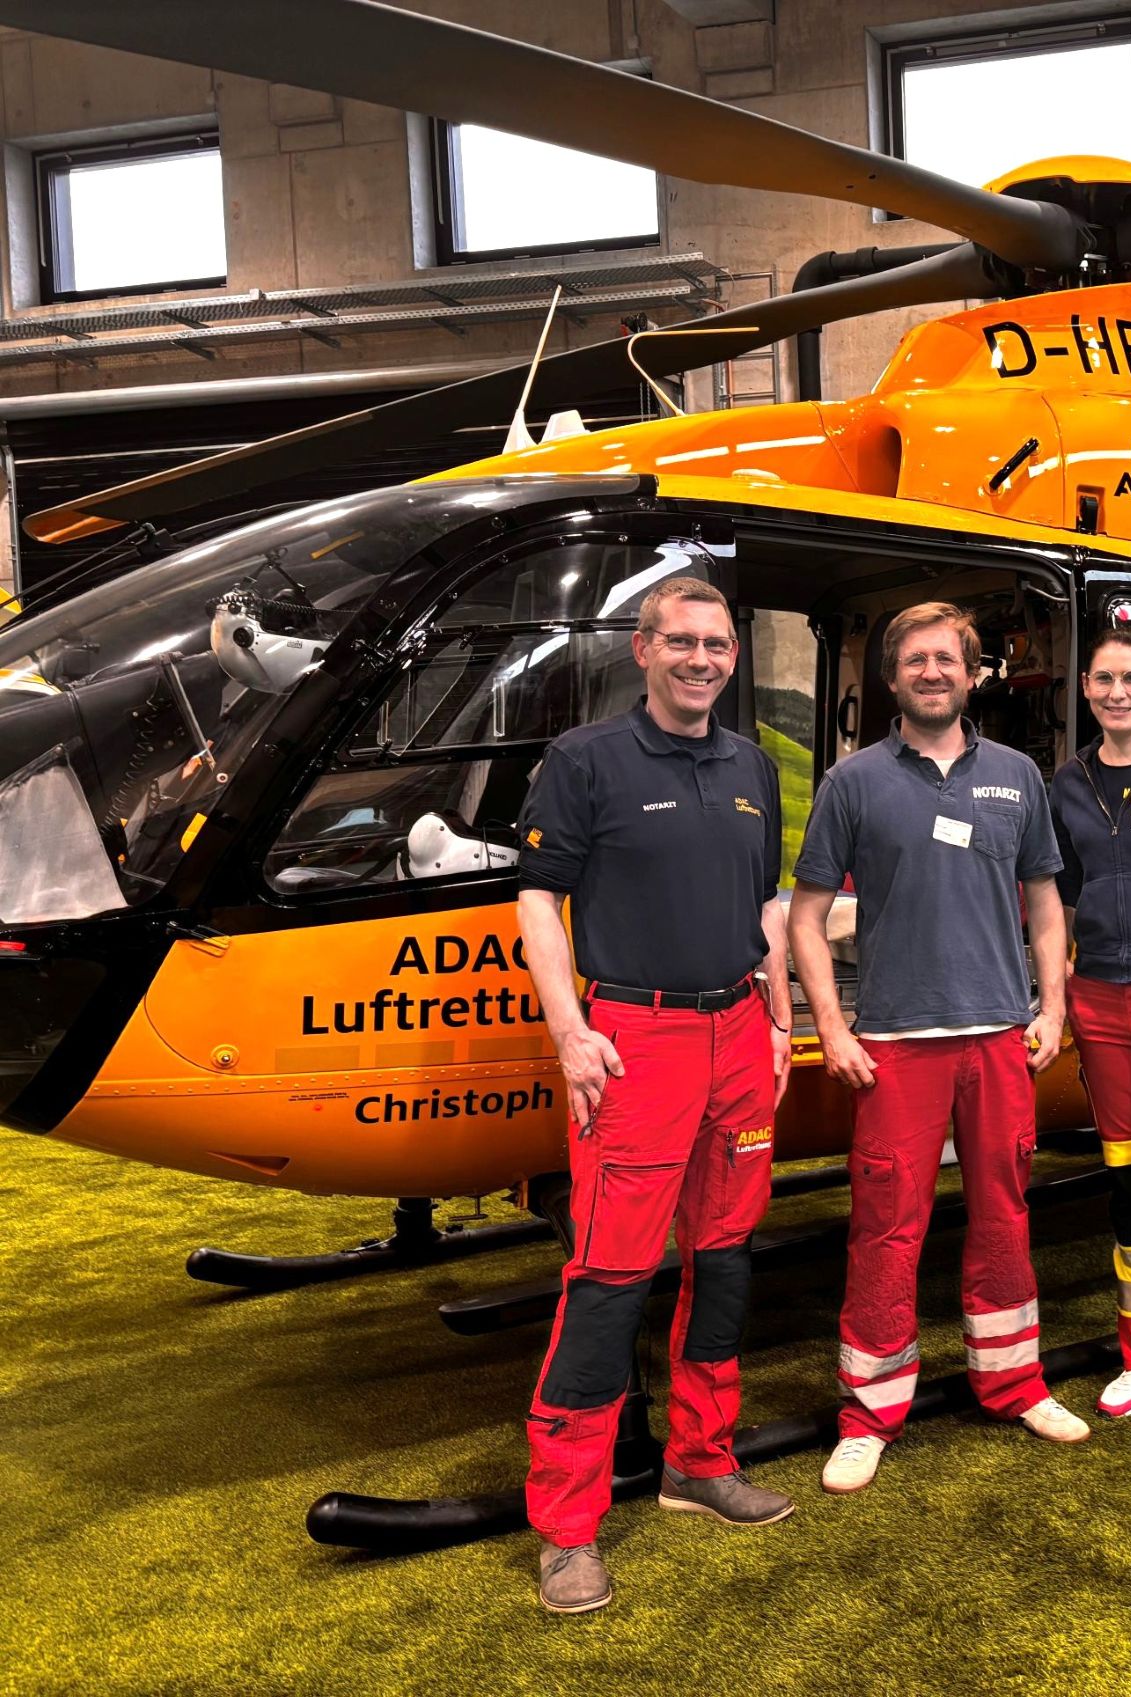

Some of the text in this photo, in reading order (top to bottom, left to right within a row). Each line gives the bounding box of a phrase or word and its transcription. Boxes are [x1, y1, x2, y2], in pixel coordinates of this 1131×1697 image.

[972, 787, 1021, 803] NOTARZT
[643, 801, 677, 811] NOTARZT
[355, 1082, 553, 1124] Christoph
[737, 1126, 772, 1144] ADAC
